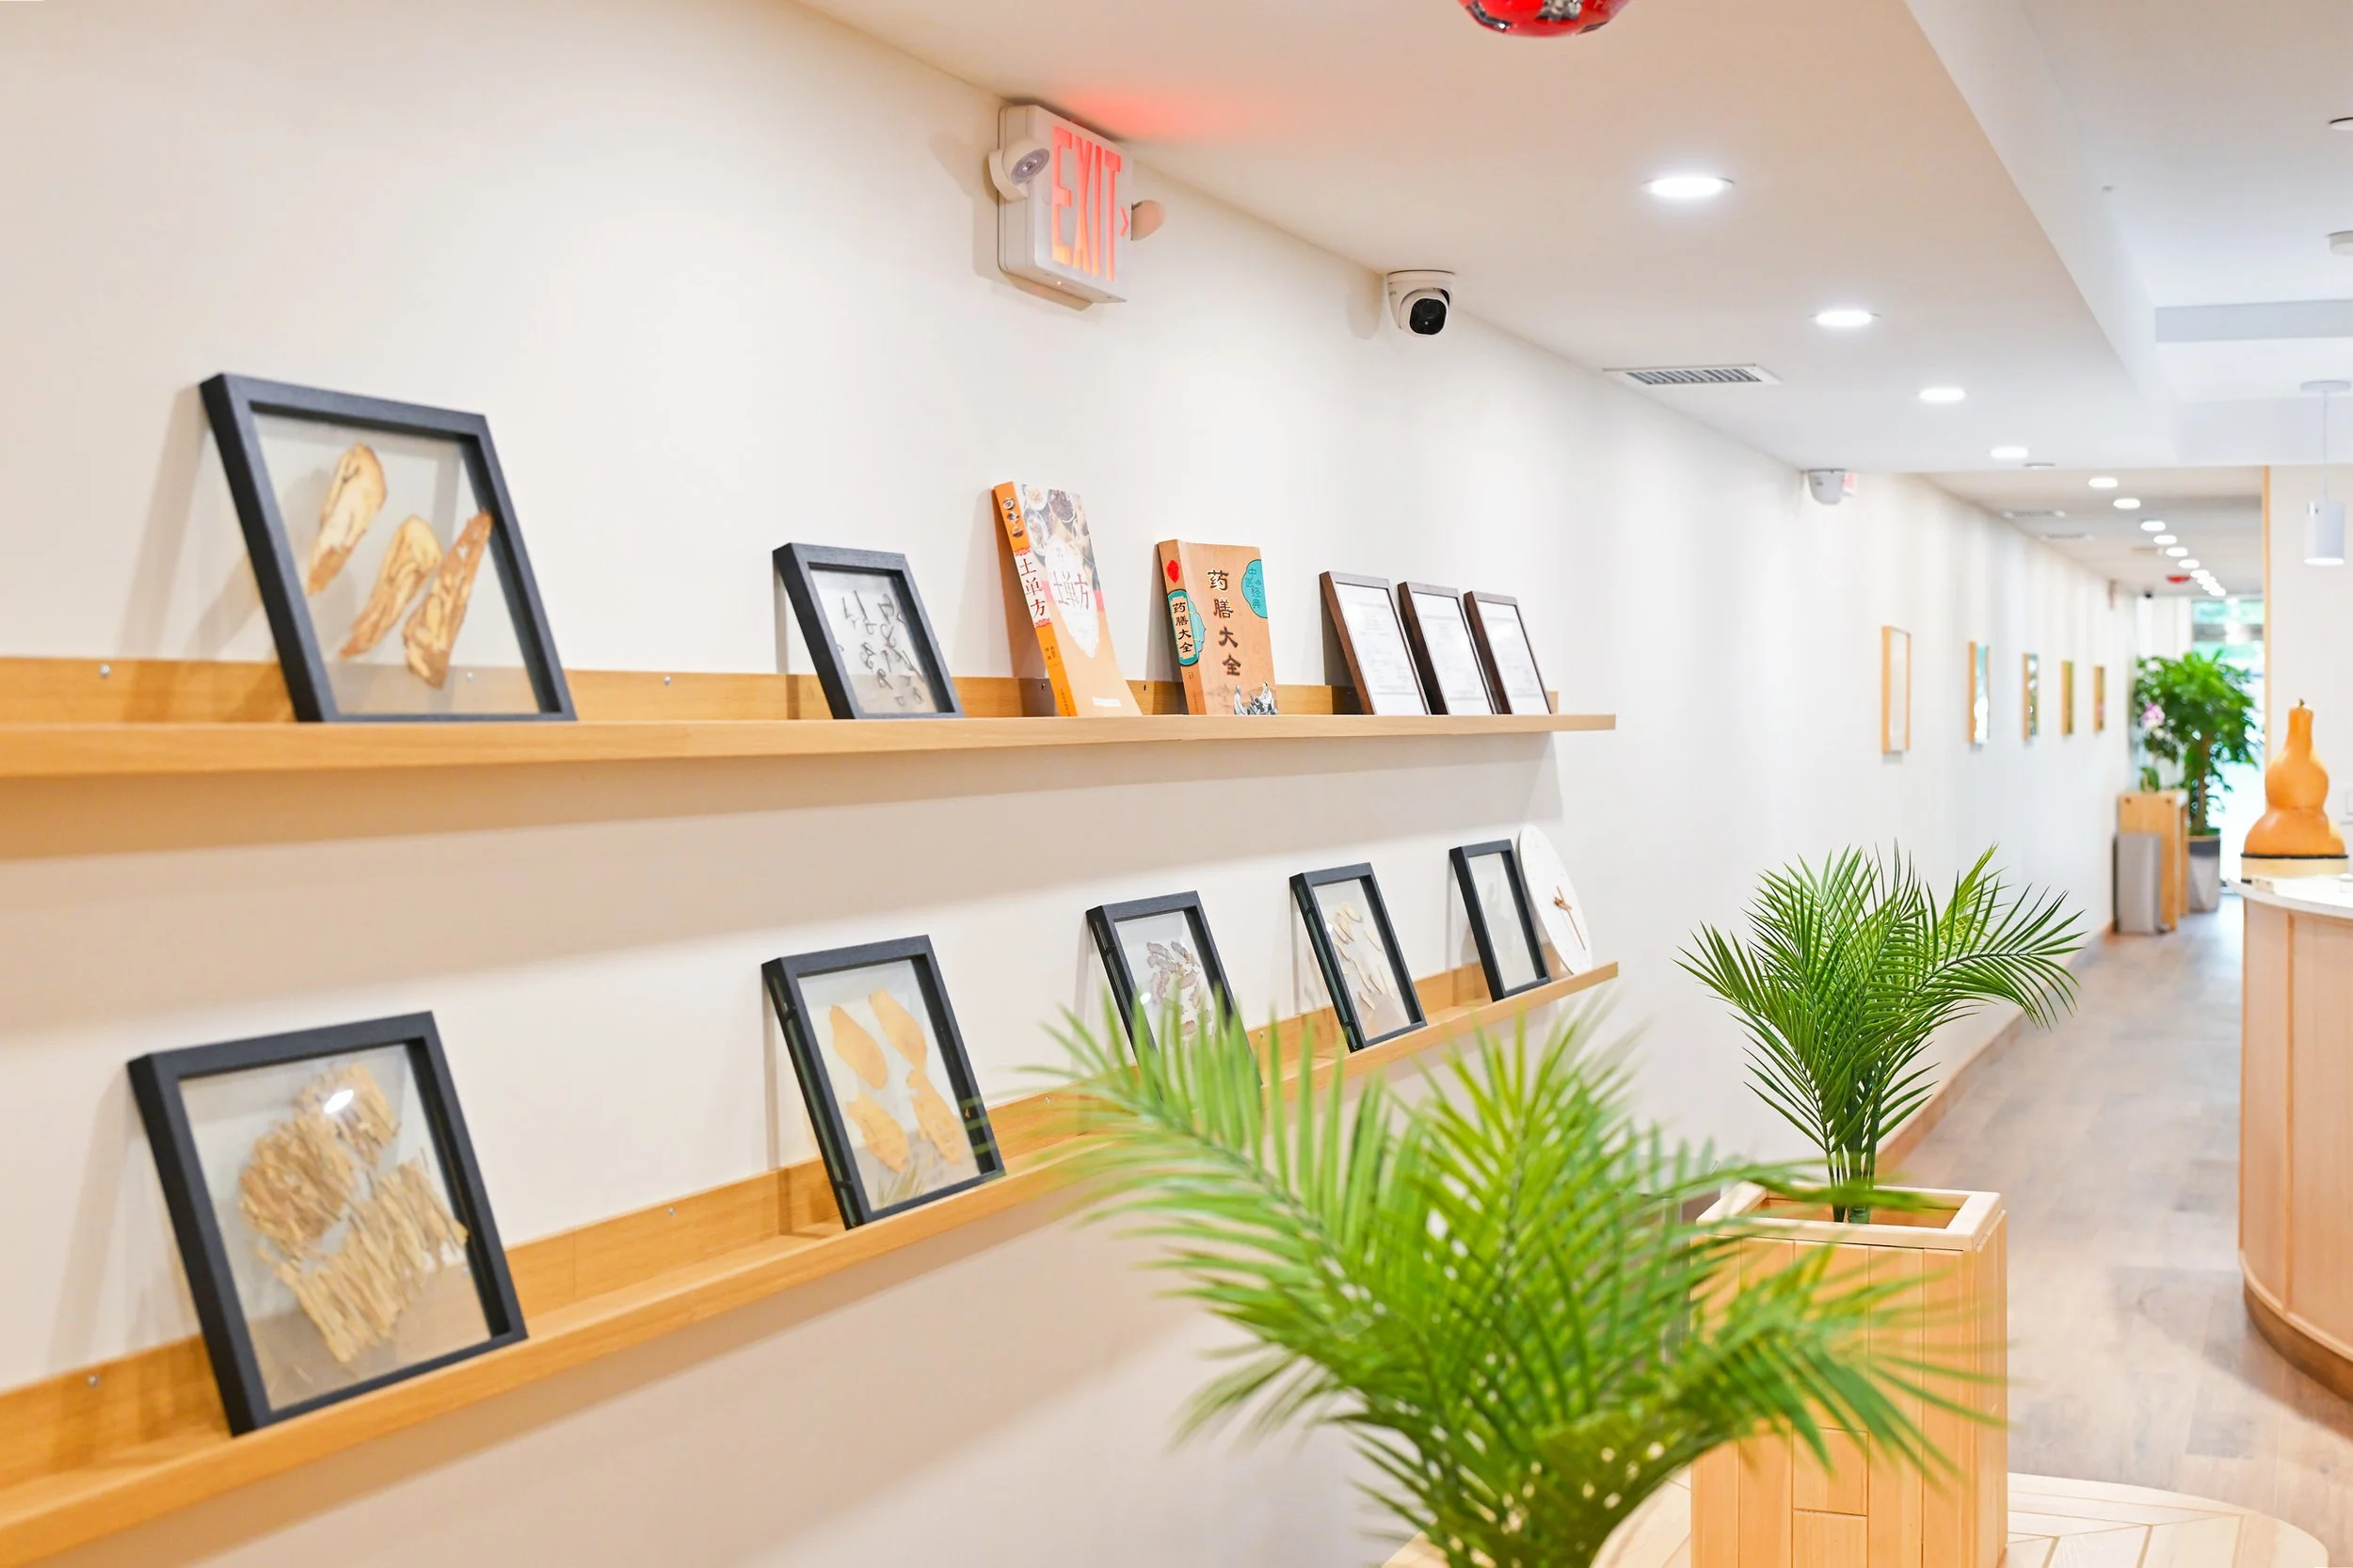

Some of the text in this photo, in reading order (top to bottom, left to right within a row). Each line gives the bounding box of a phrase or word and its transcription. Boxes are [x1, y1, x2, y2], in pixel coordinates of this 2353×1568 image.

[1051, 126, 1123, 283] EXIT
[1019, 558, 1046, 618] 土单方
[1172, 601, 1193, 653] 药膳大全
[1208, 569, 1241, 677] 药膳大全
